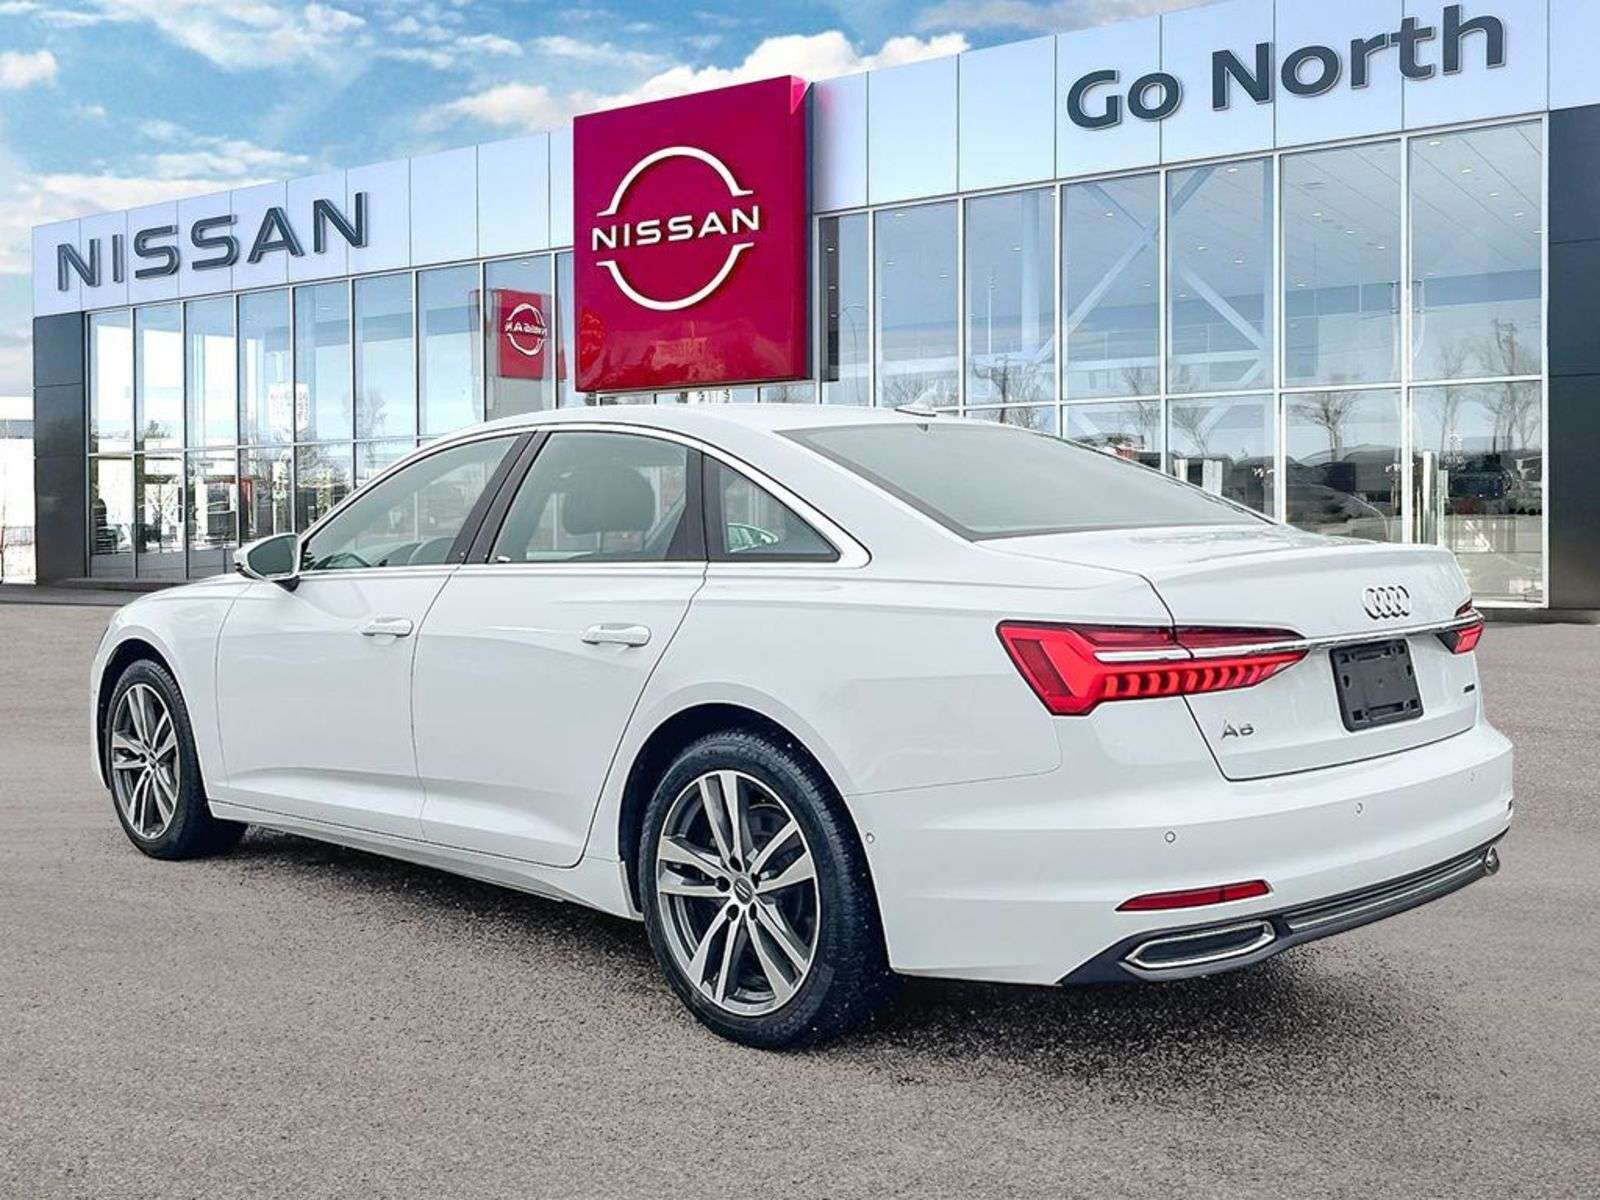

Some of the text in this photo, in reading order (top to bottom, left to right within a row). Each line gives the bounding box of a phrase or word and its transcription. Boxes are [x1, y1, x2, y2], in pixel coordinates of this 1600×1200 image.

[1066, 4, 1507, 131] Go North
[57, 191, 369, 291] NISSAN
[591, 205, 760, 251] NISSAN
